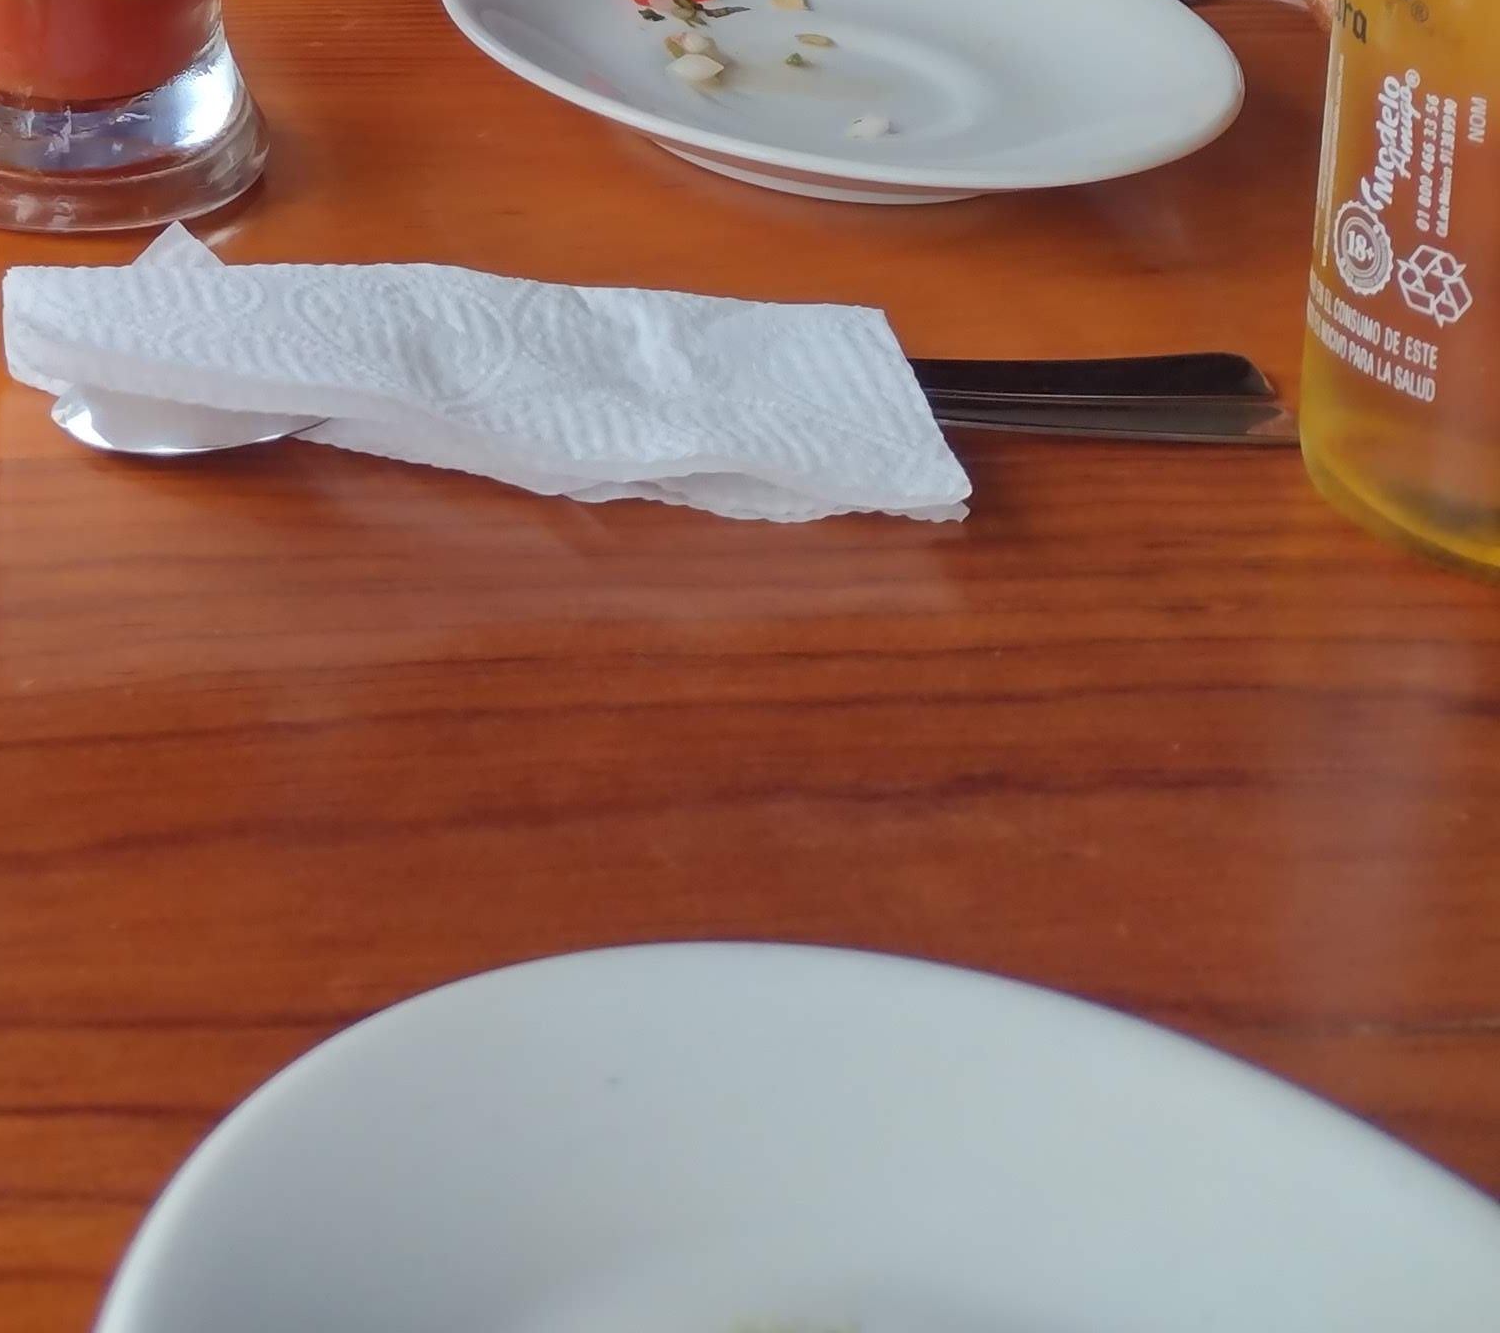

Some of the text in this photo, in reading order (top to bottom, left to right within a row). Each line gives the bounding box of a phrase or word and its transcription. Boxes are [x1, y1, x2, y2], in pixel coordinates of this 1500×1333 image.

[1373, 76, 1400, 205] Modelo
[1468, 96, 1487, 144] NOM
[1347, 230, 1375, 262] 18+
[1333, 297, 1381, 346] CONSUMO
[1384, 327, 1400, 355] DE
[1405, 336, 1438, 370] ESTE
[1348, 340, 1374, 376] PARA
[1377, 357, 1392, 384] LA
[1394, 365, 1437, 403] SALUD
